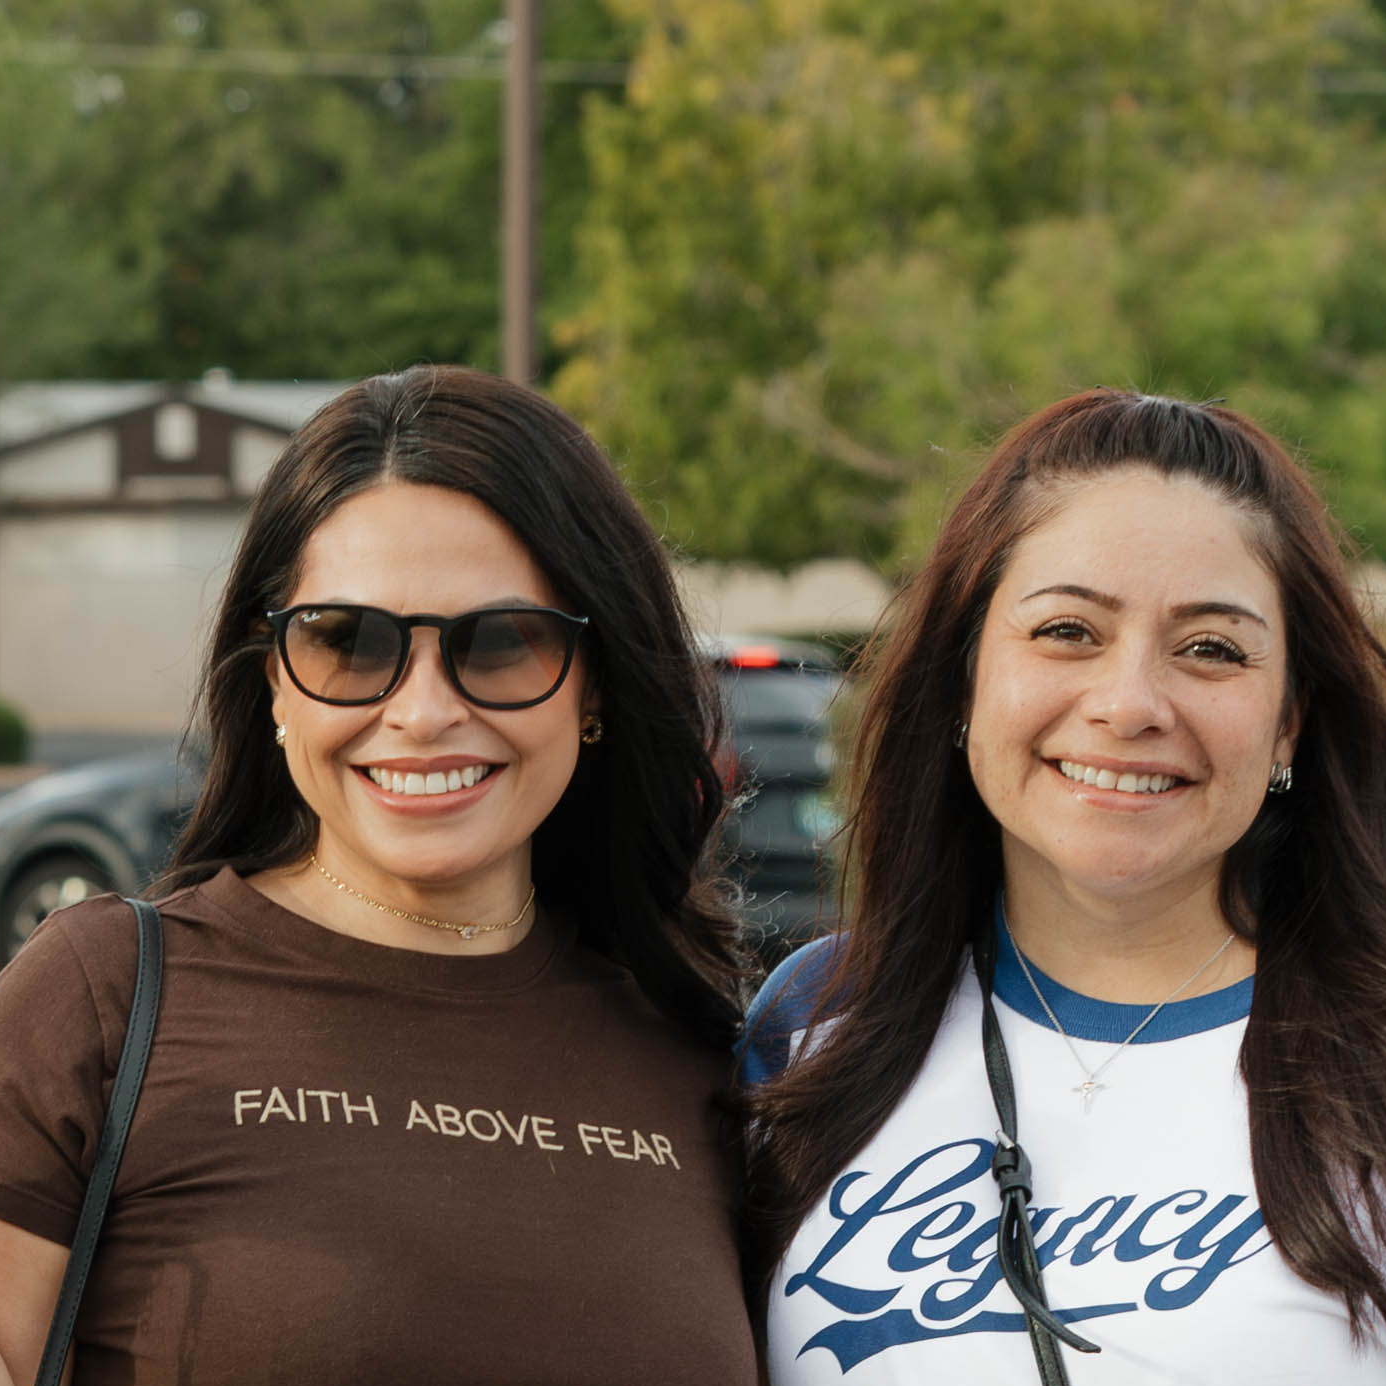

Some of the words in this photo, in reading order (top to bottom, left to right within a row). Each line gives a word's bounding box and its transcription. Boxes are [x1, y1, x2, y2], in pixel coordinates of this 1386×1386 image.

[234, 1087, 379, 1126] FAITH
[406, 1101, 564, 1151] ABOVE
[577, 1123, 681, 1170] FEAR
[784, 1138, 1275, 1321] Legacy
